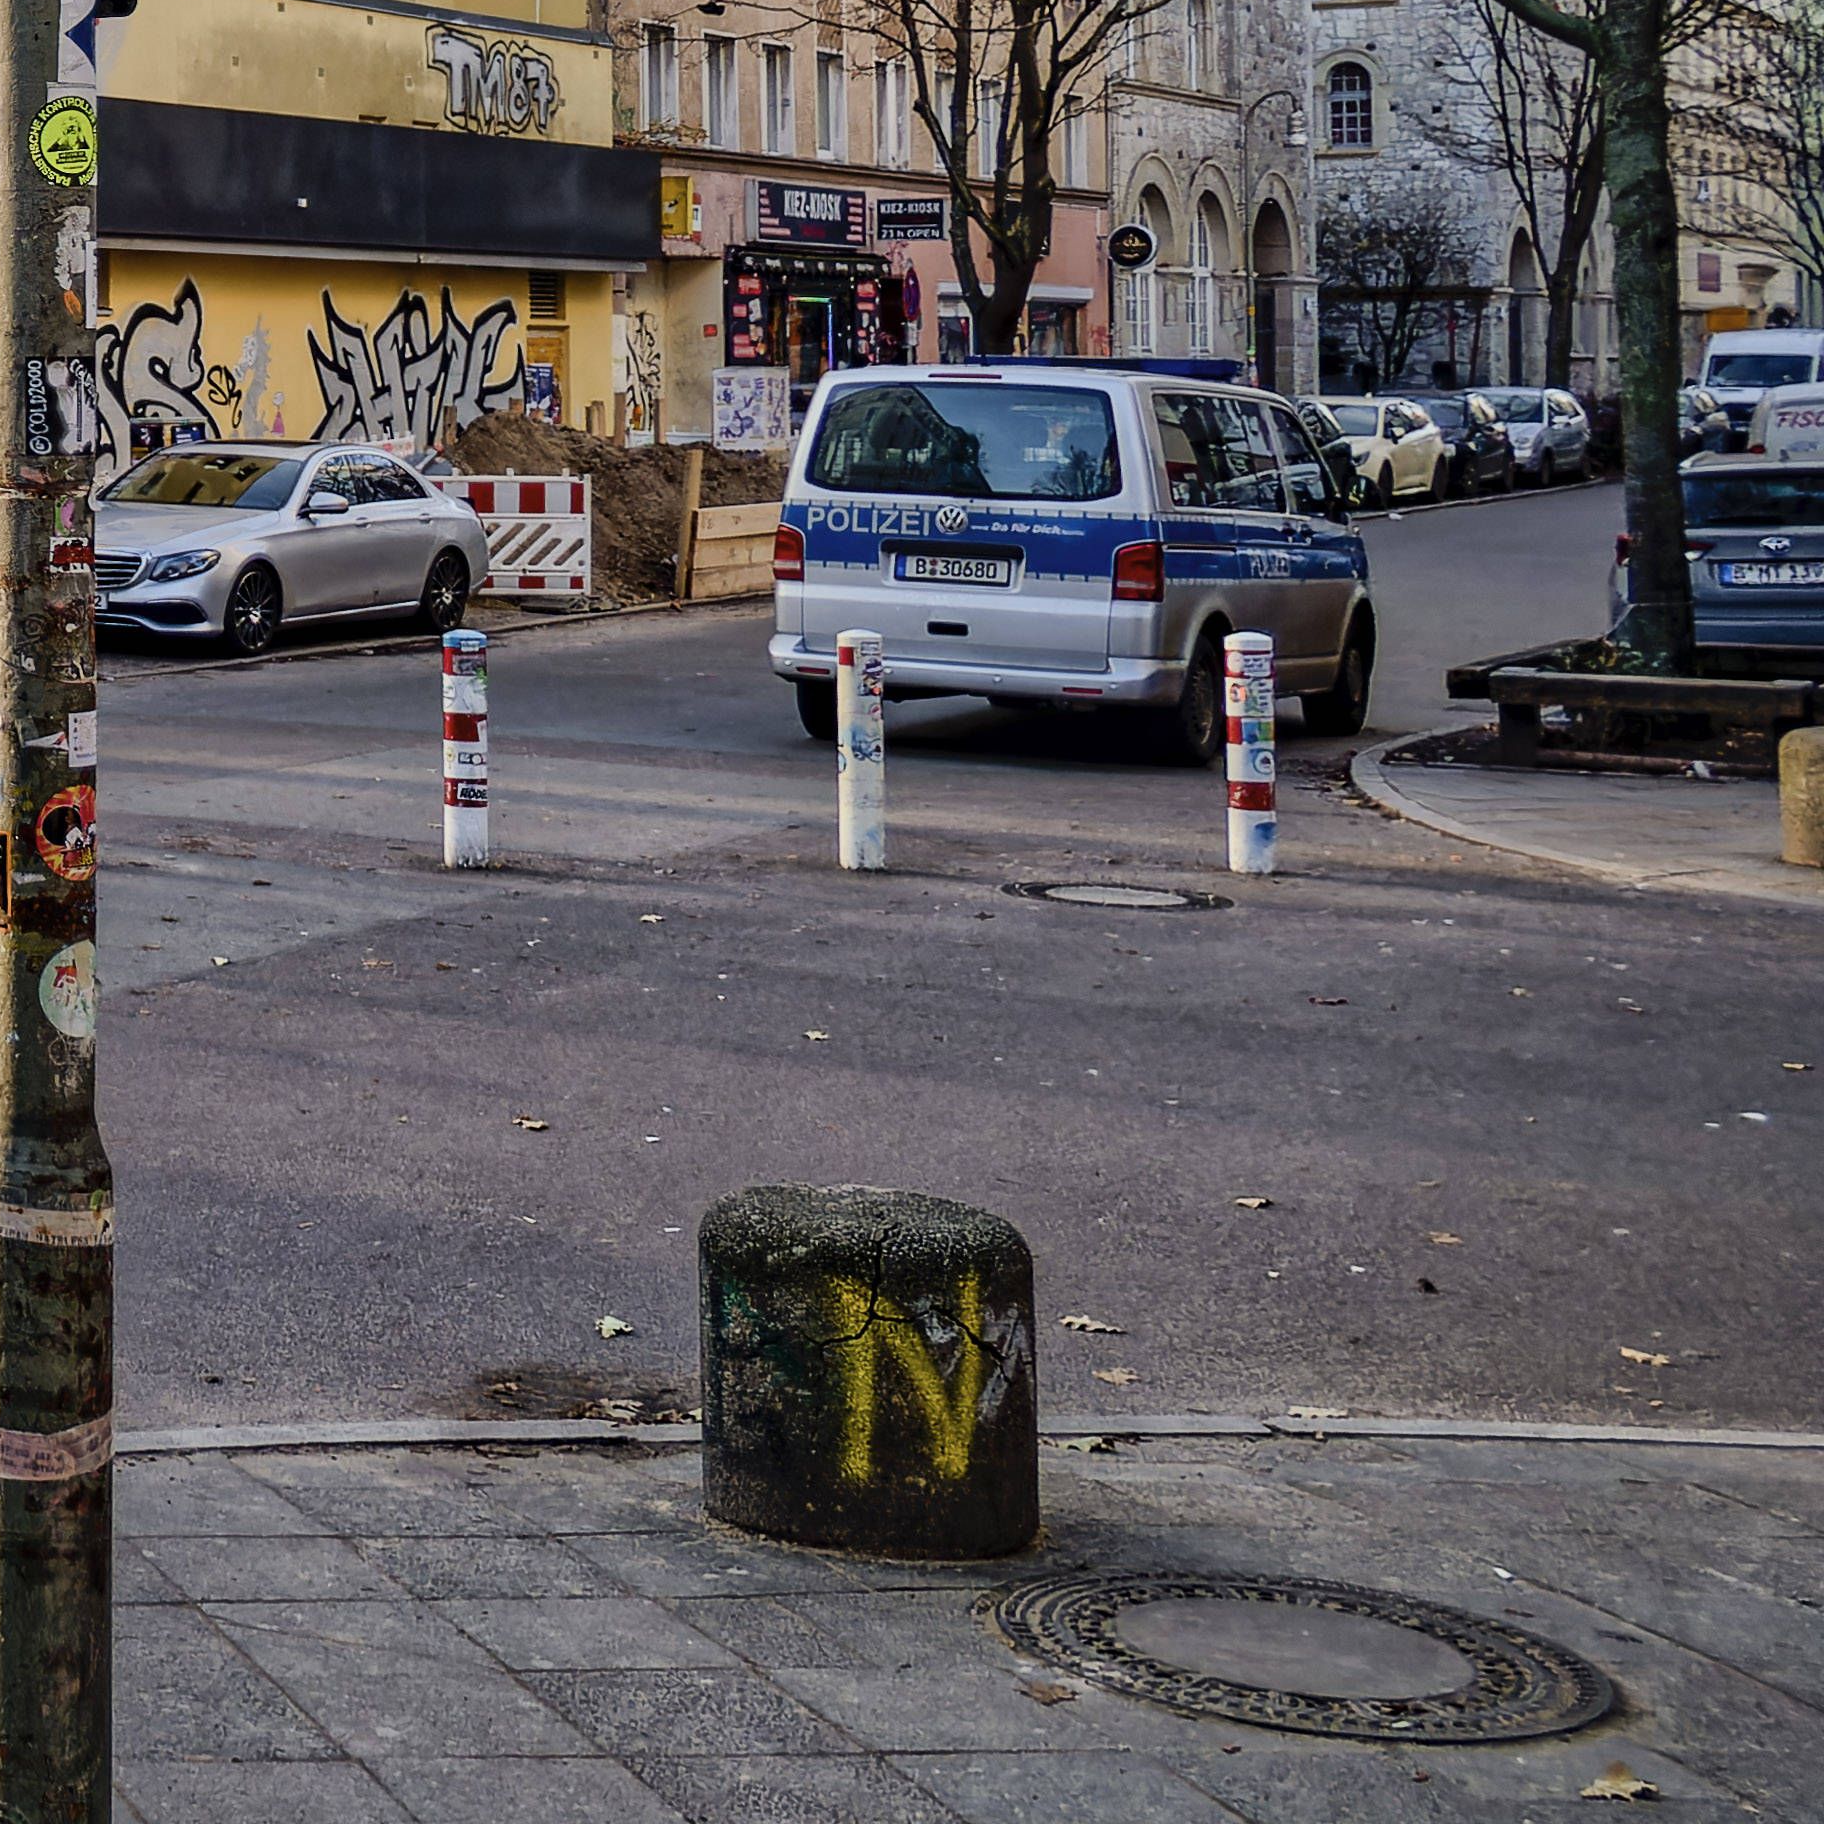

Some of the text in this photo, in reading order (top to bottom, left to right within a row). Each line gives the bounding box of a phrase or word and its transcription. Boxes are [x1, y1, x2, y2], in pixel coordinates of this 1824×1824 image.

[906, 228, 940, 239] OPEN
[807, 506, 930, 537] POLIZEI
[939, 560, 998, 579] 30680
